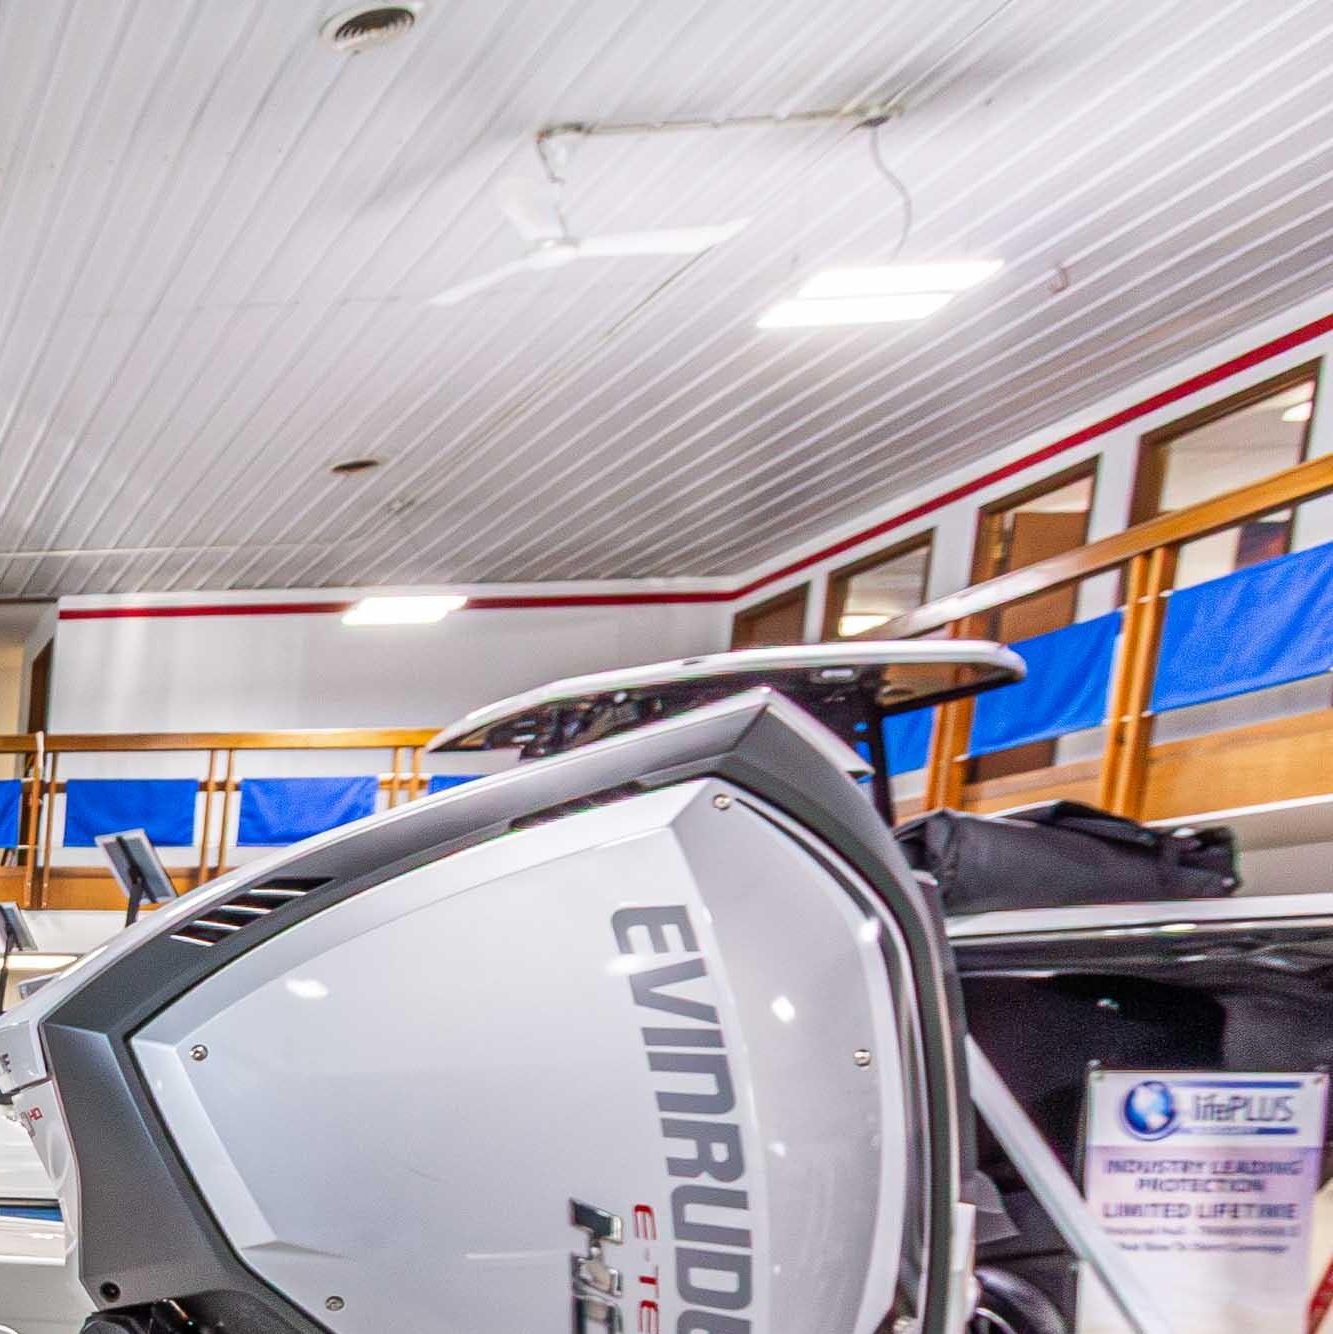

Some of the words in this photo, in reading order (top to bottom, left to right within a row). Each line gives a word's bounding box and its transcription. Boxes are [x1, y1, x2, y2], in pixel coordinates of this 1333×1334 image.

[1107, 1160, 1205, 1174] INDUSTRY
[1212, 1160, 1304, 1174] LEADING
[1136, 1178, 1266, 1193] PROTECTION
[1103, 1203, 1190, 1218] LIMITED
[1198, 1203, 1298, 1218] LIFETIME
